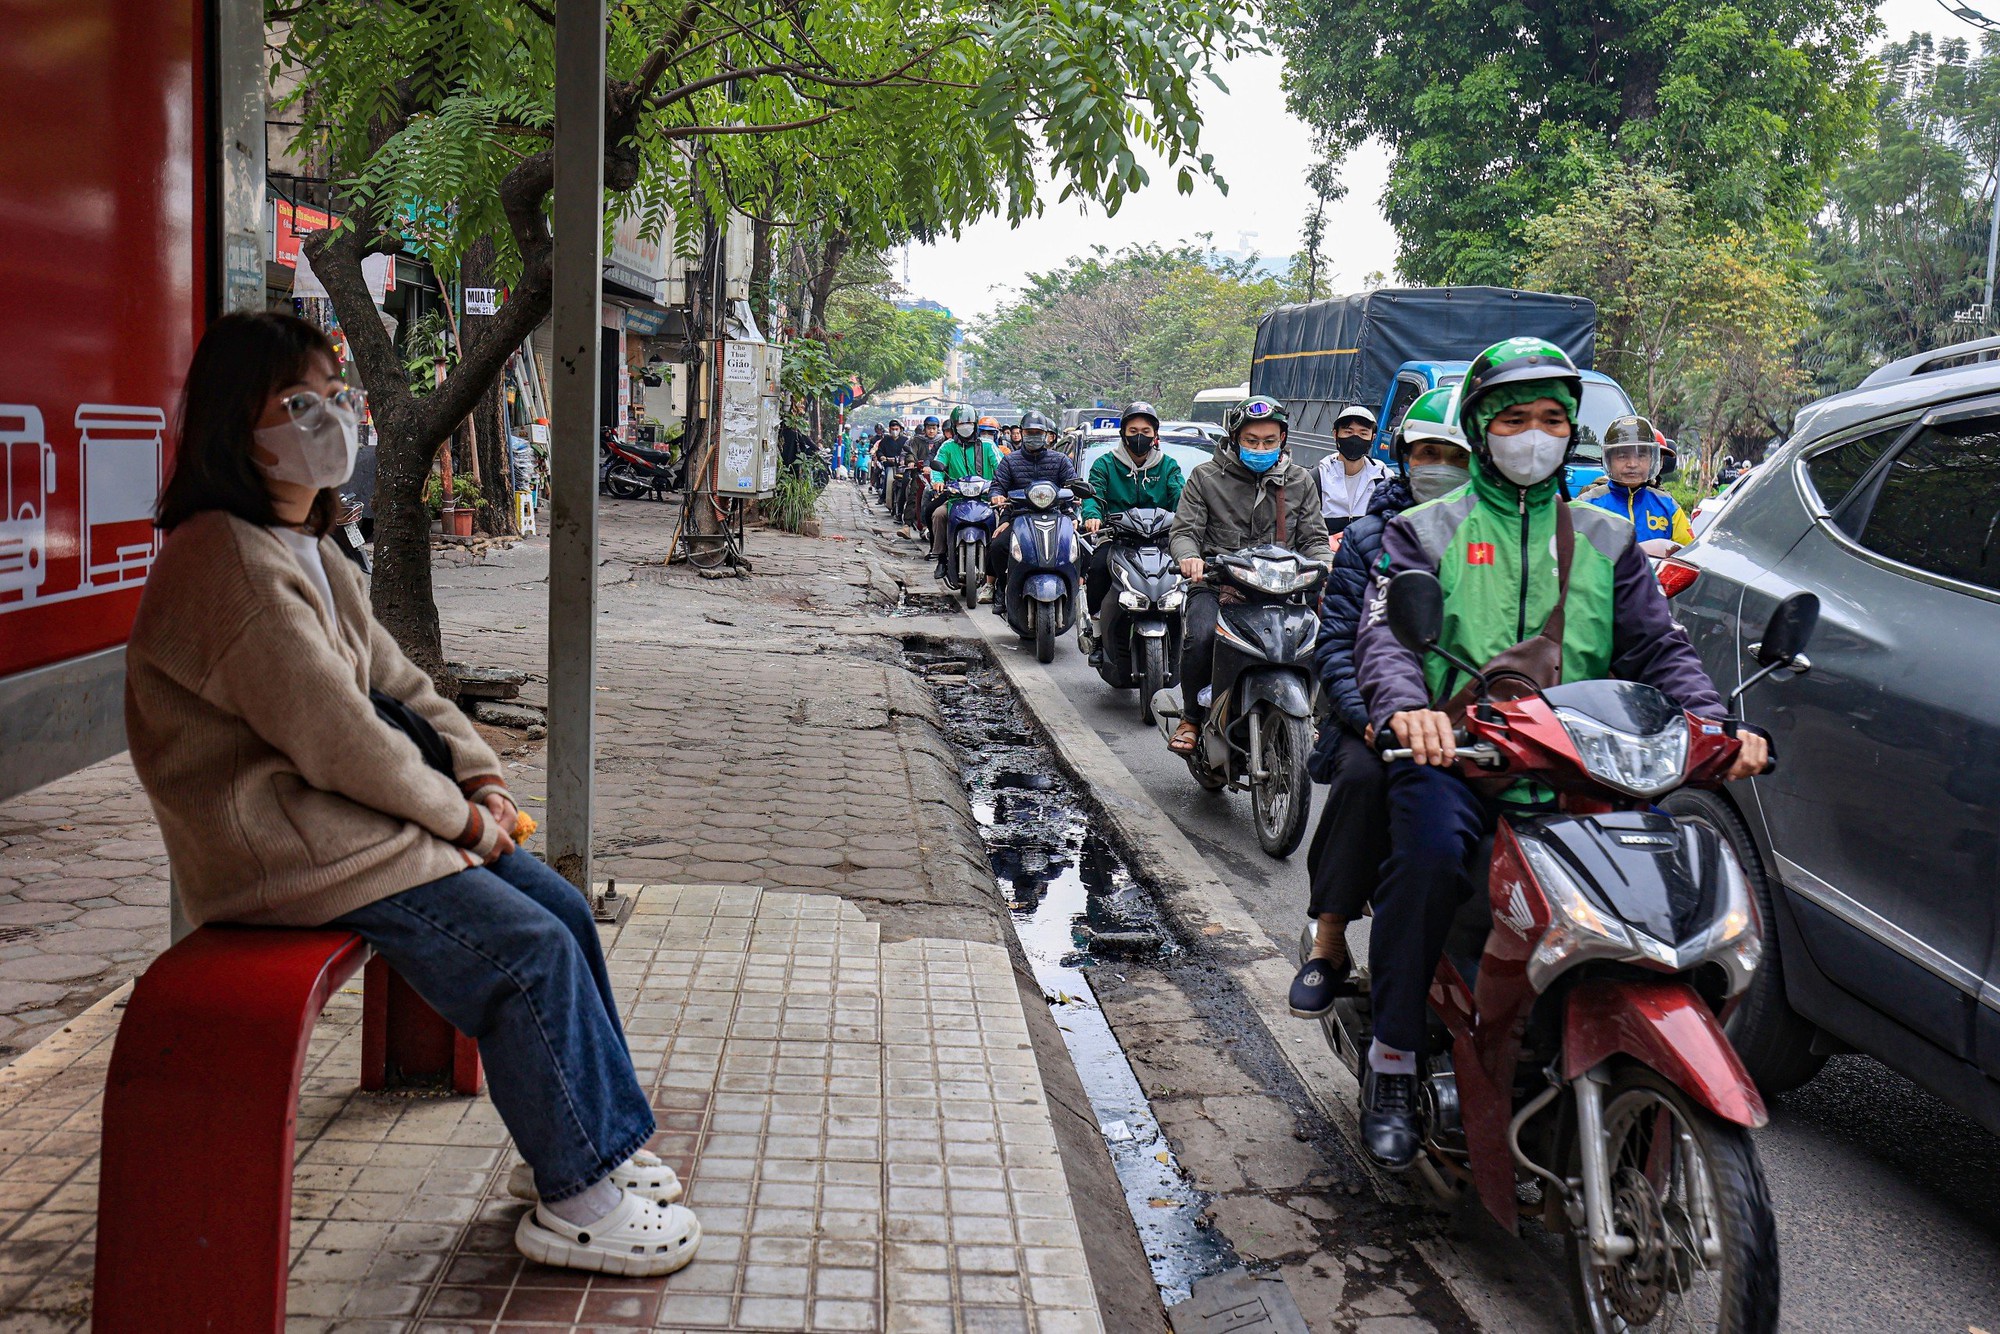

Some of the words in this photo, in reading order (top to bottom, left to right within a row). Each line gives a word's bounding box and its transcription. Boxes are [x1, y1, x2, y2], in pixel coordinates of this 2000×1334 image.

[467, 290, 486, 303] MUA
[727, 359, 750, 369] Giáo
[1646, 510, 1669, 531] be
[1367, 575, 1390, 626] gojek
[1619, 835, 1674, 845] HONDA
[1494, 908, 1529, 942] HONDA
